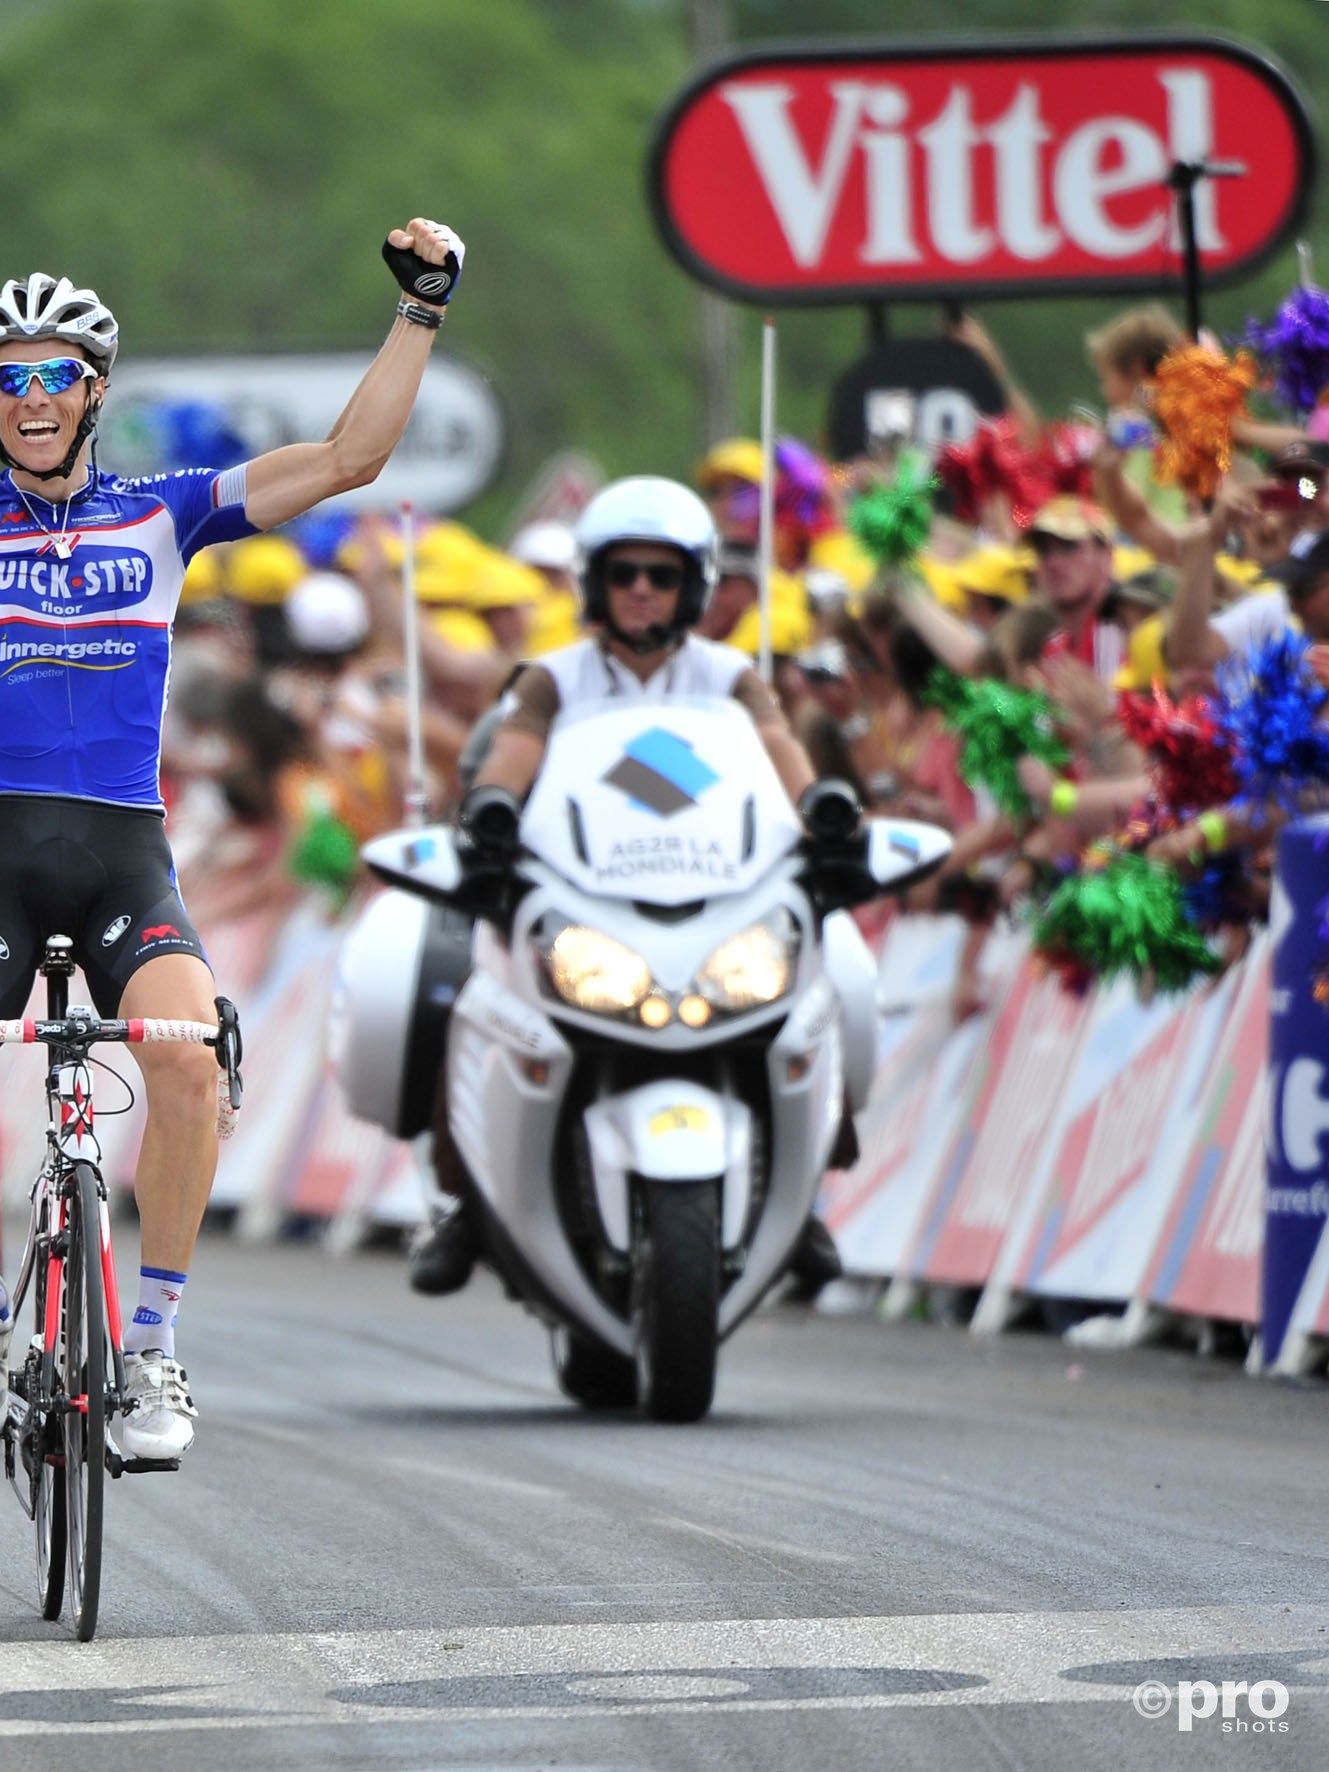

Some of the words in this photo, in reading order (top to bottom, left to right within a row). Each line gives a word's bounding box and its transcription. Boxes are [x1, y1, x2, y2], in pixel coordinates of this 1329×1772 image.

[719, 68, 1227, 270] Vittel
[76, 311, 100, 331] BBB
[41, 600, 83, 616] floor
[0, 632, 137, 662] innergetic
[7, 670, 34, 686] Sleep
[35, 667, 65, 680] better
[611, 836, 682, 857] AG2R
[689, 838, 722, 856] LA
[595, 856, 738, 883] MONDIALE
